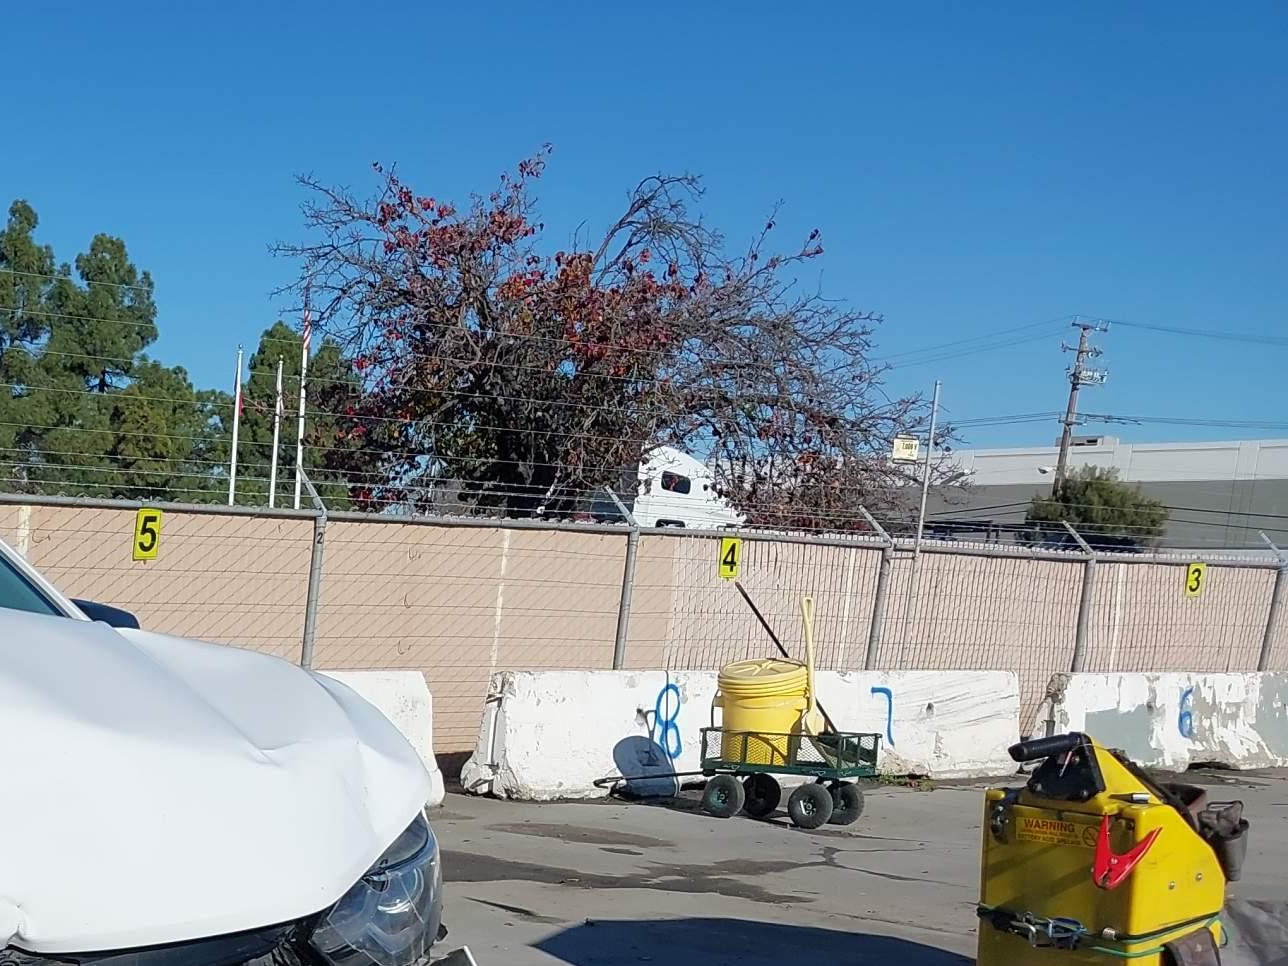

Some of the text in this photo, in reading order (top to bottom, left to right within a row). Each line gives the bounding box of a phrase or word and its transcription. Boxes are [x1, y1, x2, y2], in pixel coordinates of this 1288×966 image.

[138, 515, 157, 553] 5
[316, 531, 324, 545] 2
[722, 542, 737, 573] 4
[1188, 567, 1202, 593] 3
[656, 684, 683, 759] 8
[870, 687, 895, 747] 7
[1177, 686, 1195, 739] 6
[1023, 818, 1076, 833] WARNING
